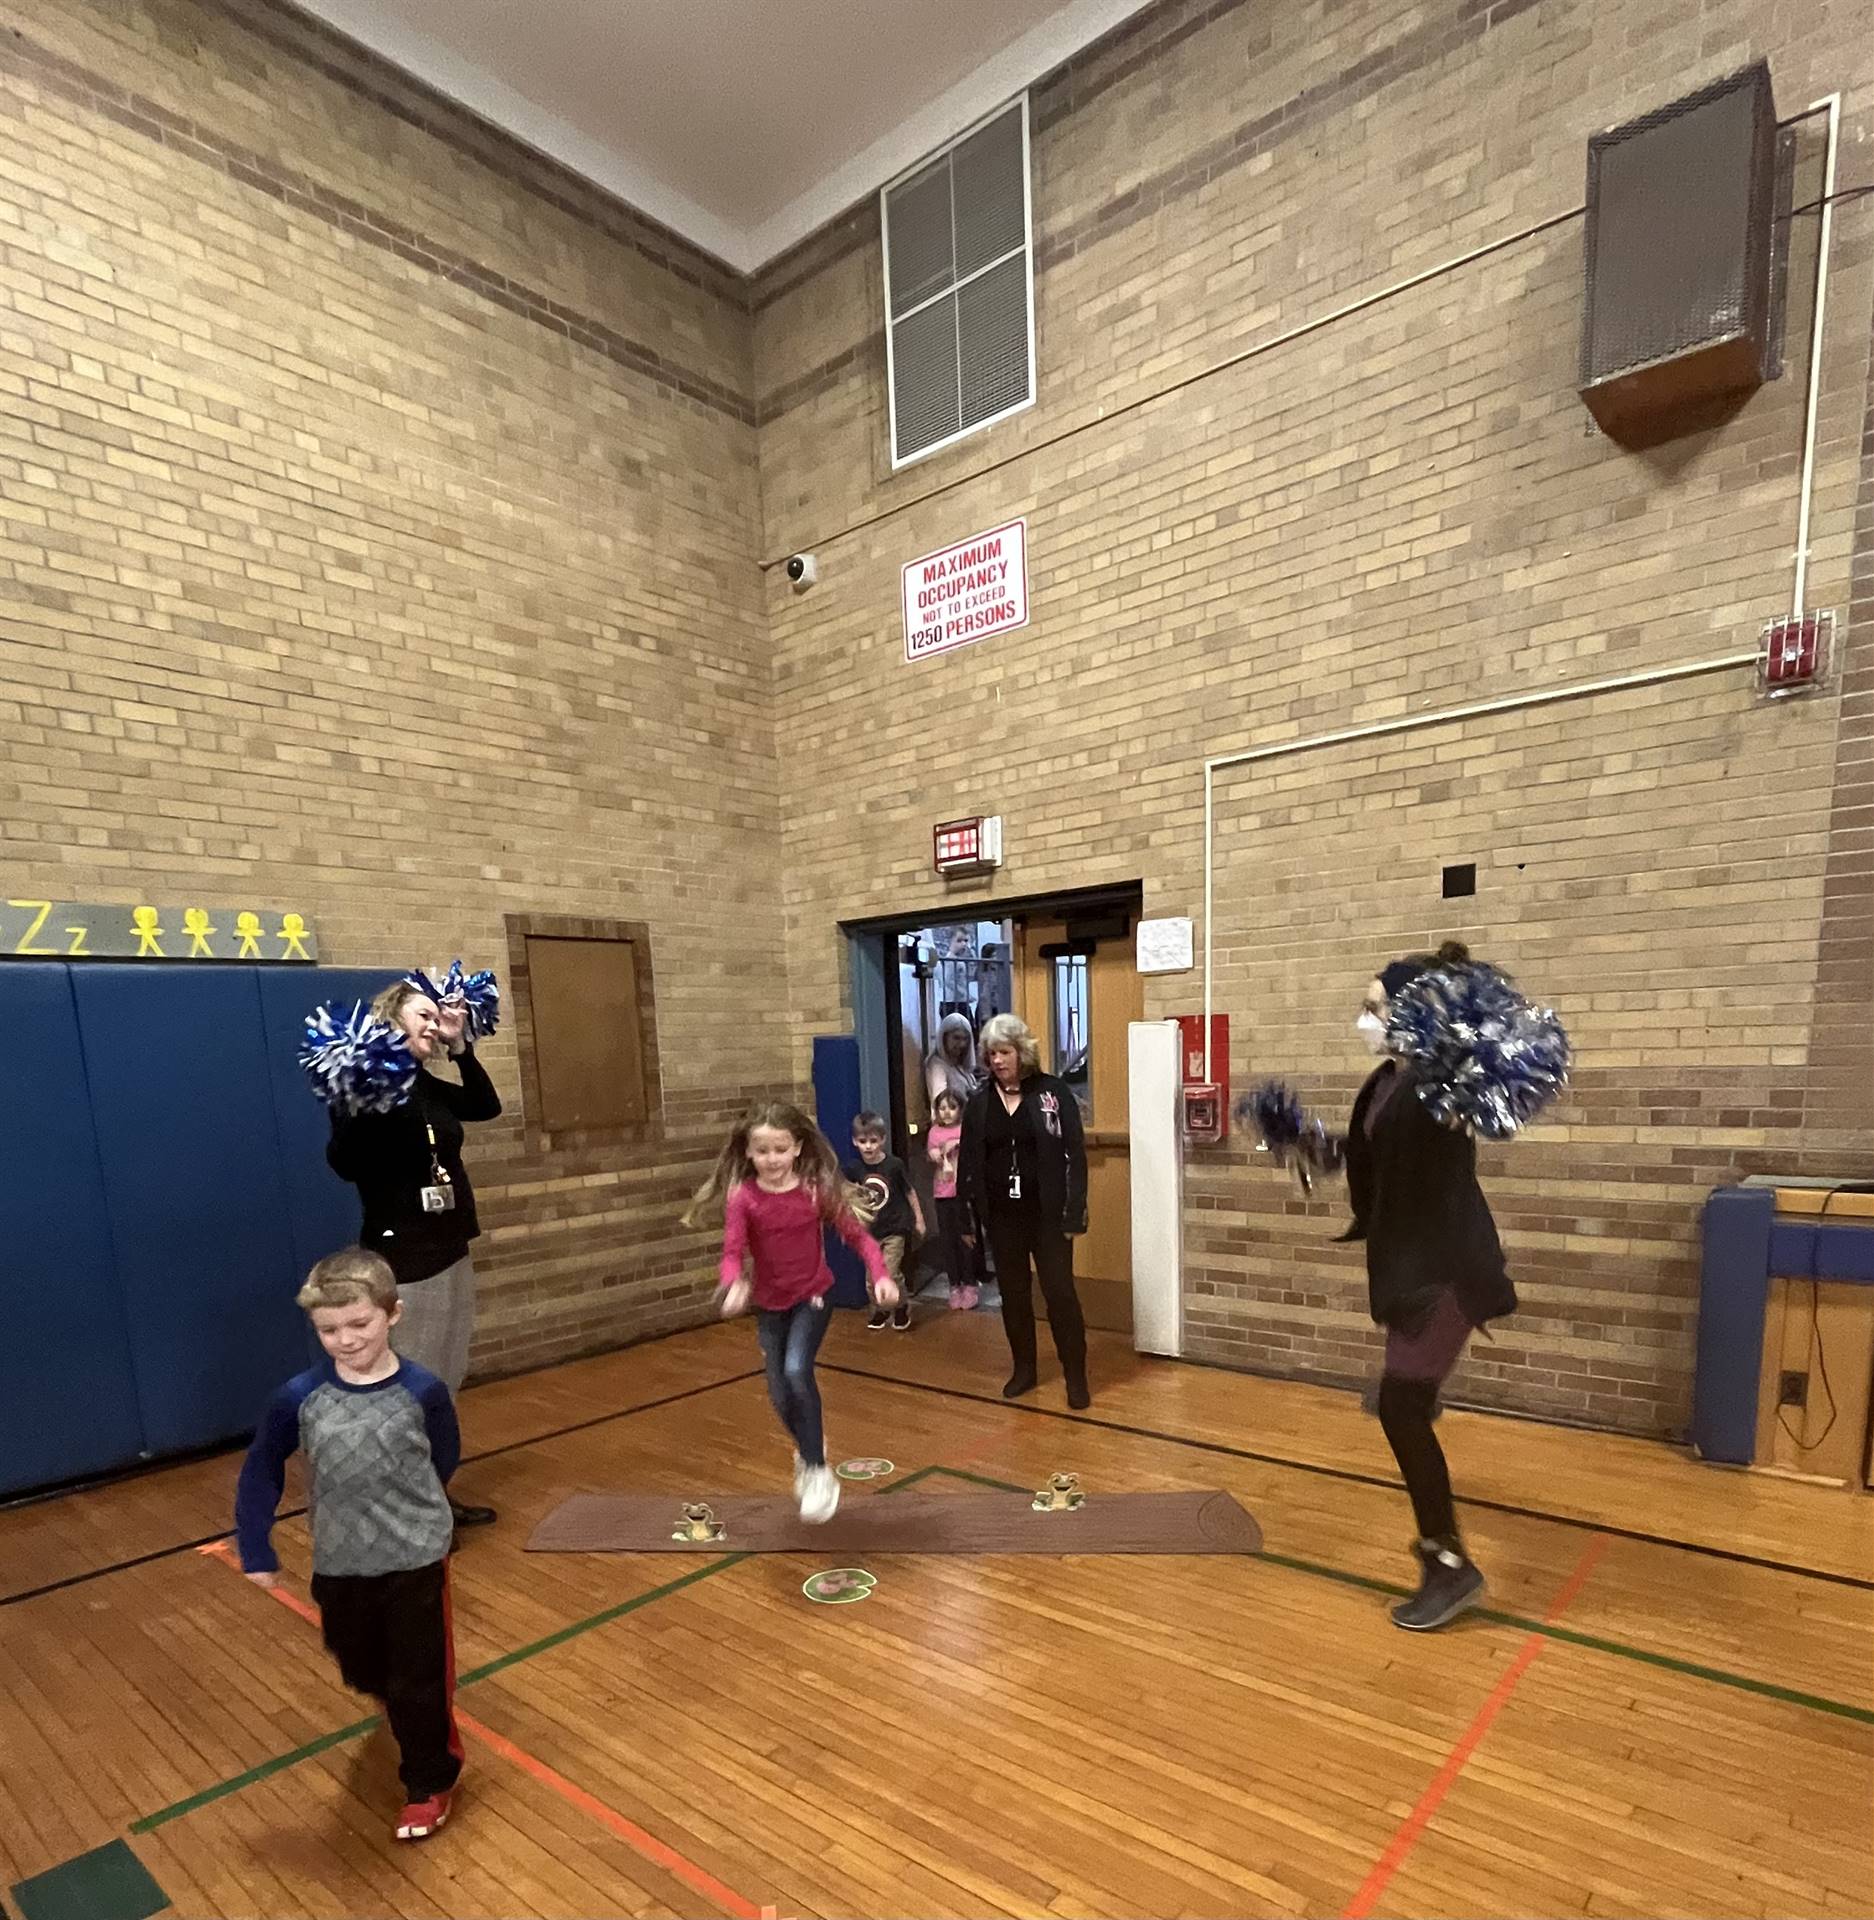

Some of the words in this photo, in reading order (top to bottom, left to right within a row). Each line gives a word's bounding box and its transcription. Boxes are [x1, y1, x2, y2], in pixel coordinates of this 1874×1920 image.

[918, 559, 1008, 609] OCCUPANCY
[923, 538, 1002, 585] MAXIMUM
[911, 625, 943, 650] 1250
[946, 600, 1016, 639] PERSONS
[923, 607, 943, 625] NOT
[948, 601, 961, 616] TO
[965, 585, 1006, 610] EXCEED
